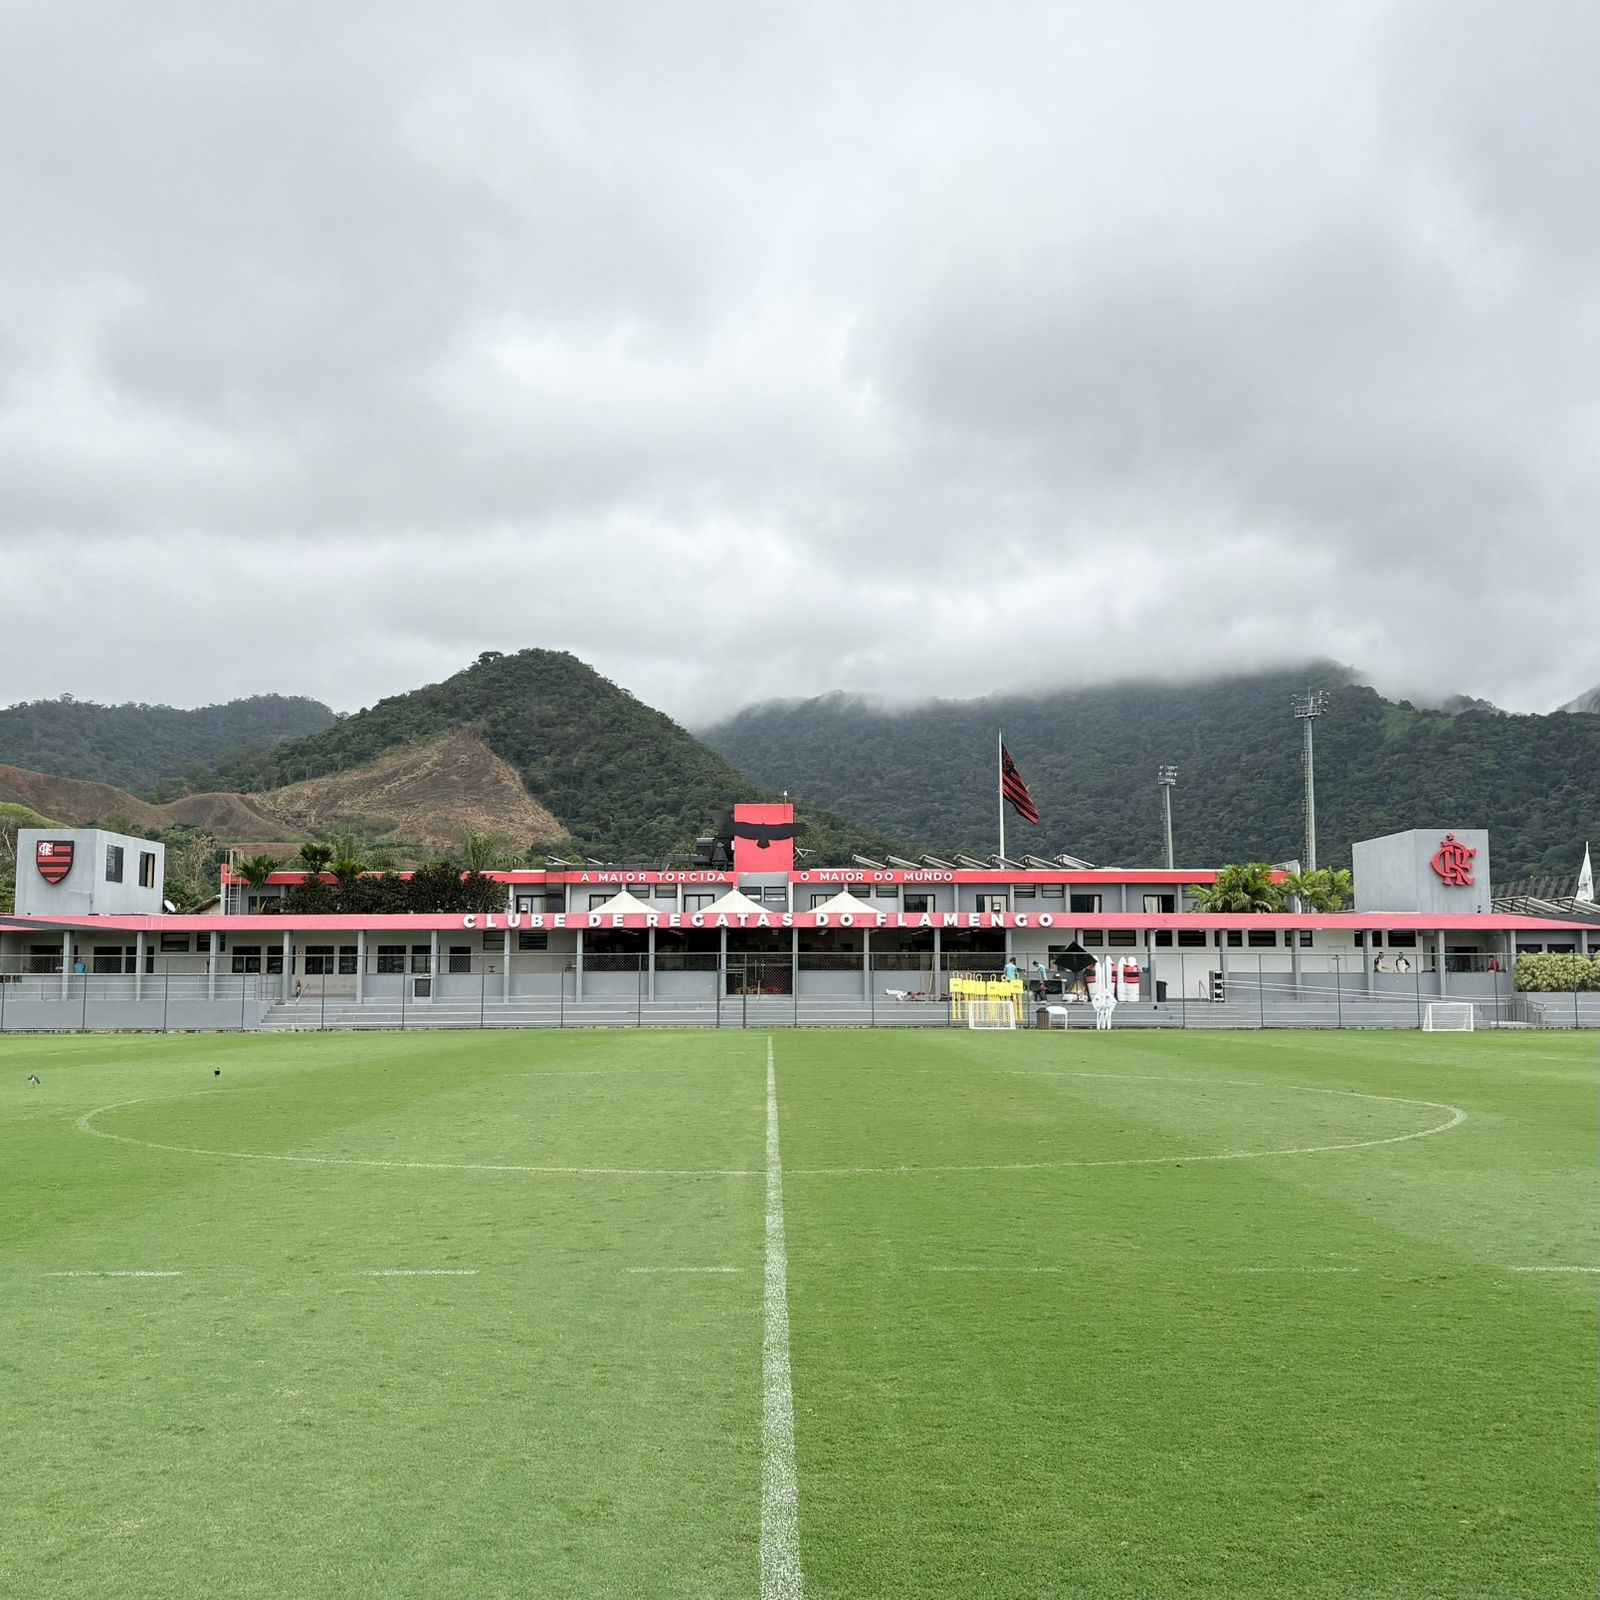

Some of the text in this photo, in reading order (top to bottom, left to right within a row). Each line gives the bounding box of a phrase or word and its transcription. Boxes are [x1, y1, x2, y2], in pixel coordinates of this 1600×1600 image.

[581, 872, 727, 882] A MAIOR TORCIDA
[800, 872, 954, 882] O MAIOR DO MUNDO
[463, 913, 1054, 928] CLUBE DE REGATAS DO FLAMENGO
